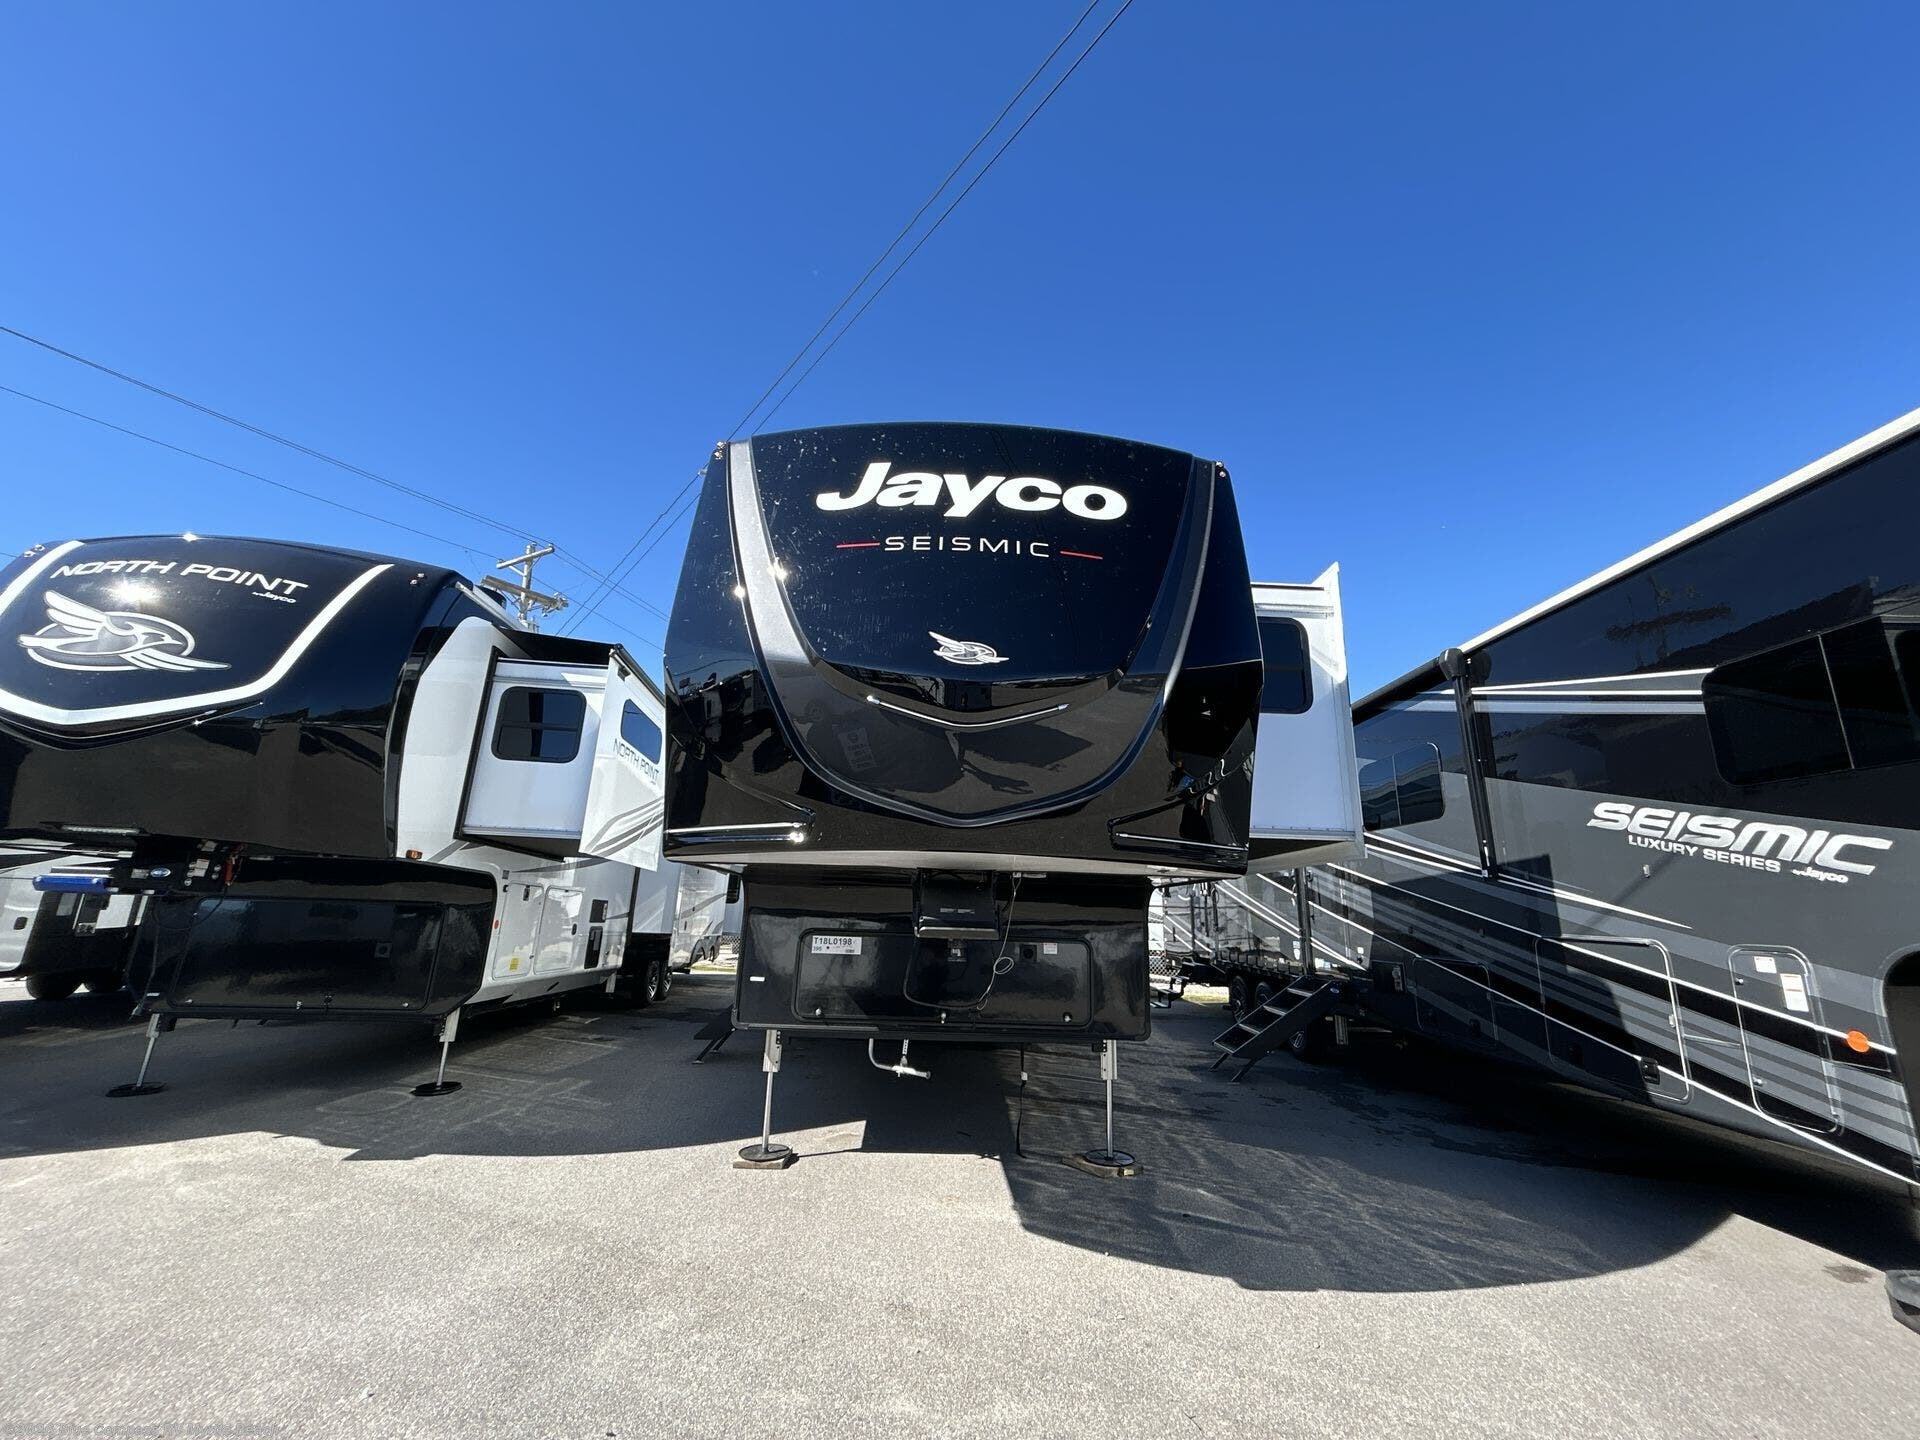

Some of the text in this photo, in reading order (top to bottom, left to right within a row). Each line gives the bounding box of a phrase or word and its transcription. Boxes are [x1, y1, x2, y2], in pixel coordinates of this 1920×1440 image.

[815, 461, 1128, 521] Jayco
[884, 535, 1050, 558] SEISMIC
[50, 560, 308, 595] NORTH POINT
[613, 738, 640, 768] NORTH
[1586, 801, 1894, 876] SEISMIC
[1627, 834, 1782, 873] LUXURY SERIES
[814, 937, 853, 946] T18L0198
